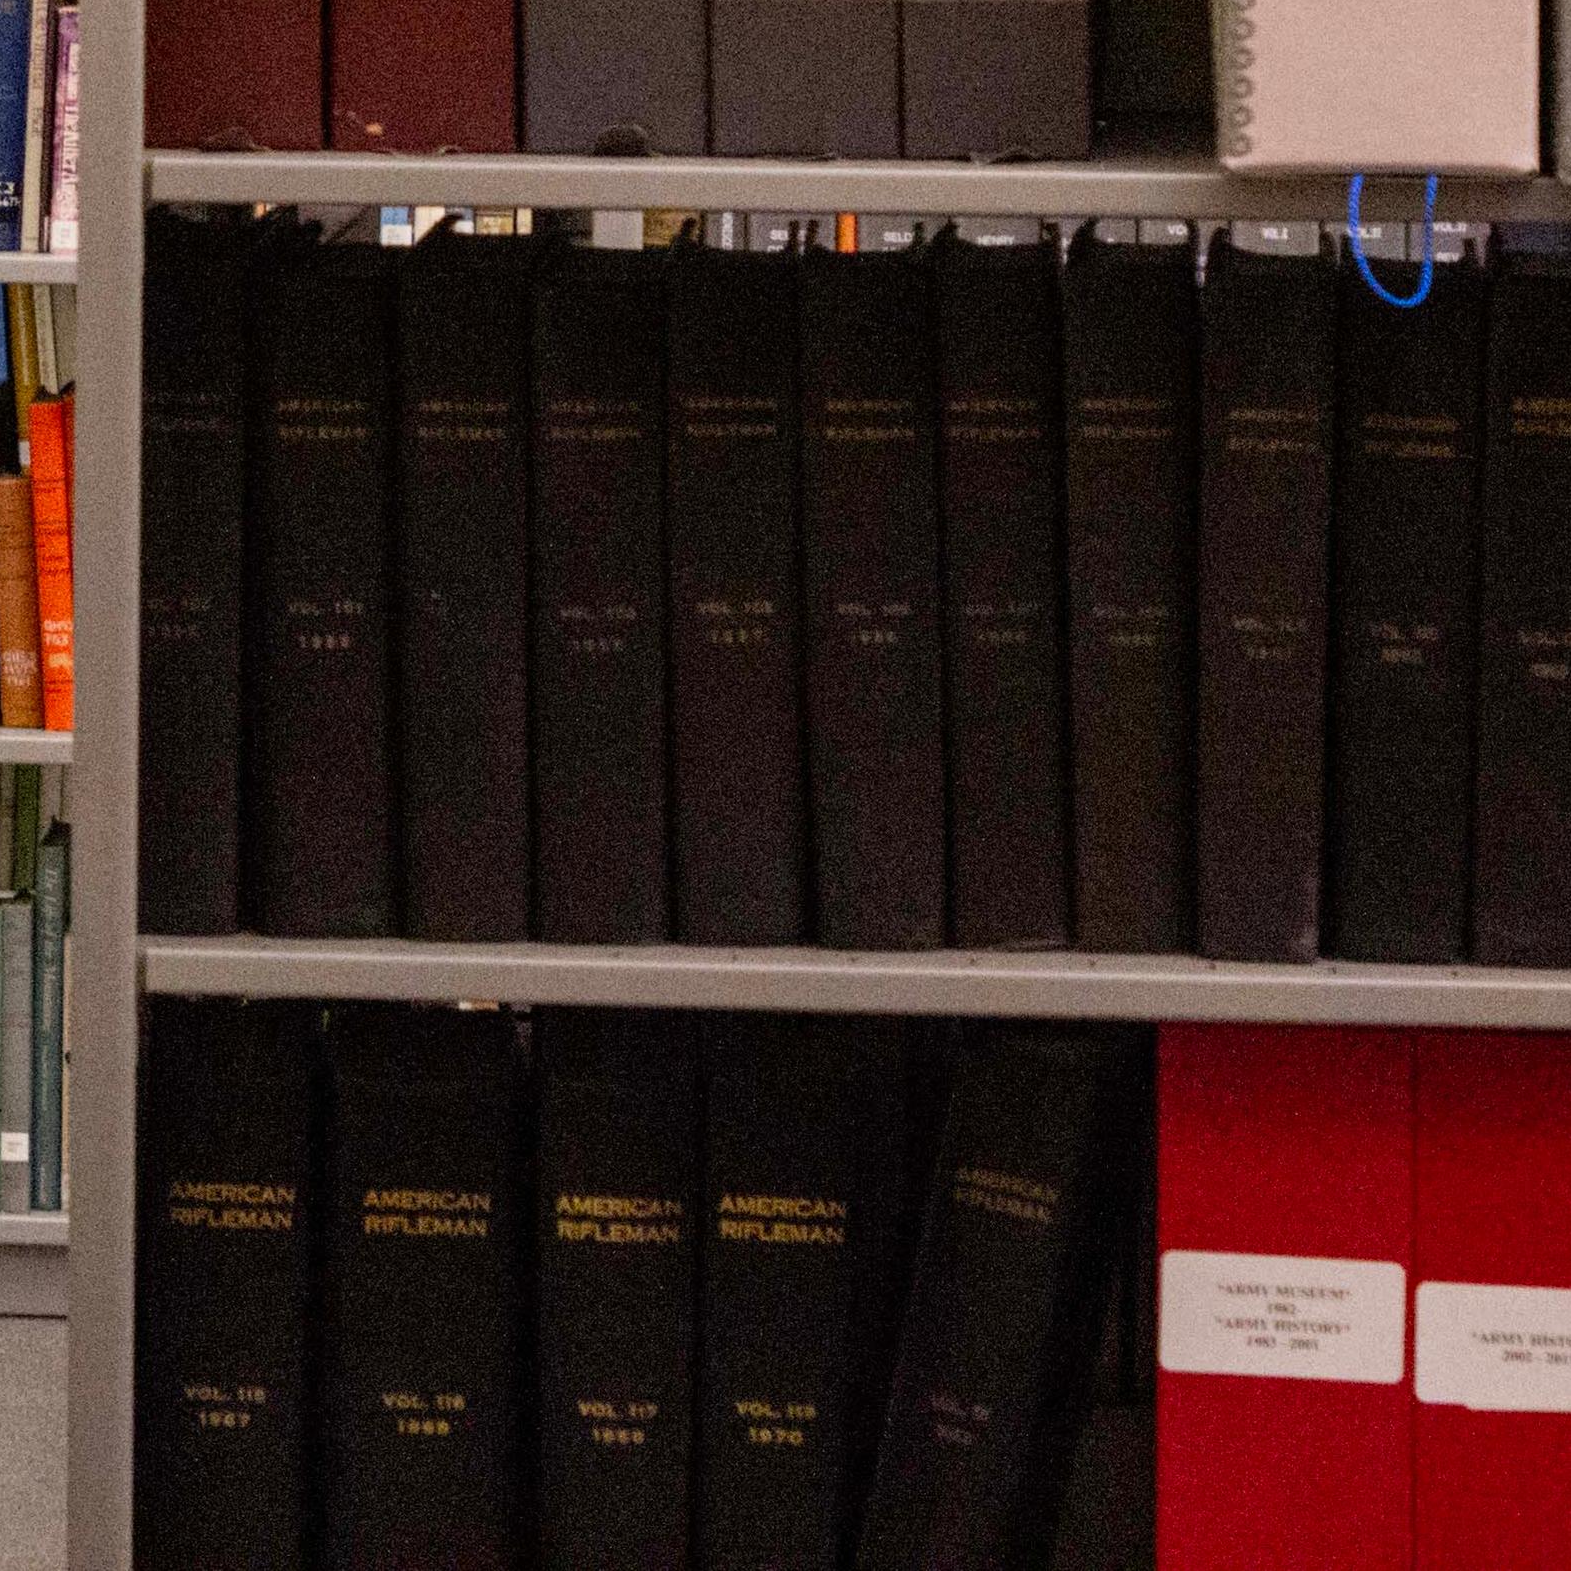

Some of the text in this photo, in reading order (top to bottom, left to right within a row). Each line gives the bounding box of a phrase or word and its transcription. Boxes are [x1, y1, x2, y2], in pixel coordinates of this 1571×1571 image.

[170, 1182, 296, 1206] AMERICAN
[362, 1189, 492, 1213] AMERICAN
[556, 1196, 684, 1217] AMERICAN
[719, 1195, 847, 1218] AMERICAN
[170, 1208, 293, 1229] RIFLEMAN
[362, 1215, 488, 1236] RIFLEMAN
[557, 1221, 680, 1244] RIFLEMAN
[718, 1220, 845, 1244] RIFLEMAN
